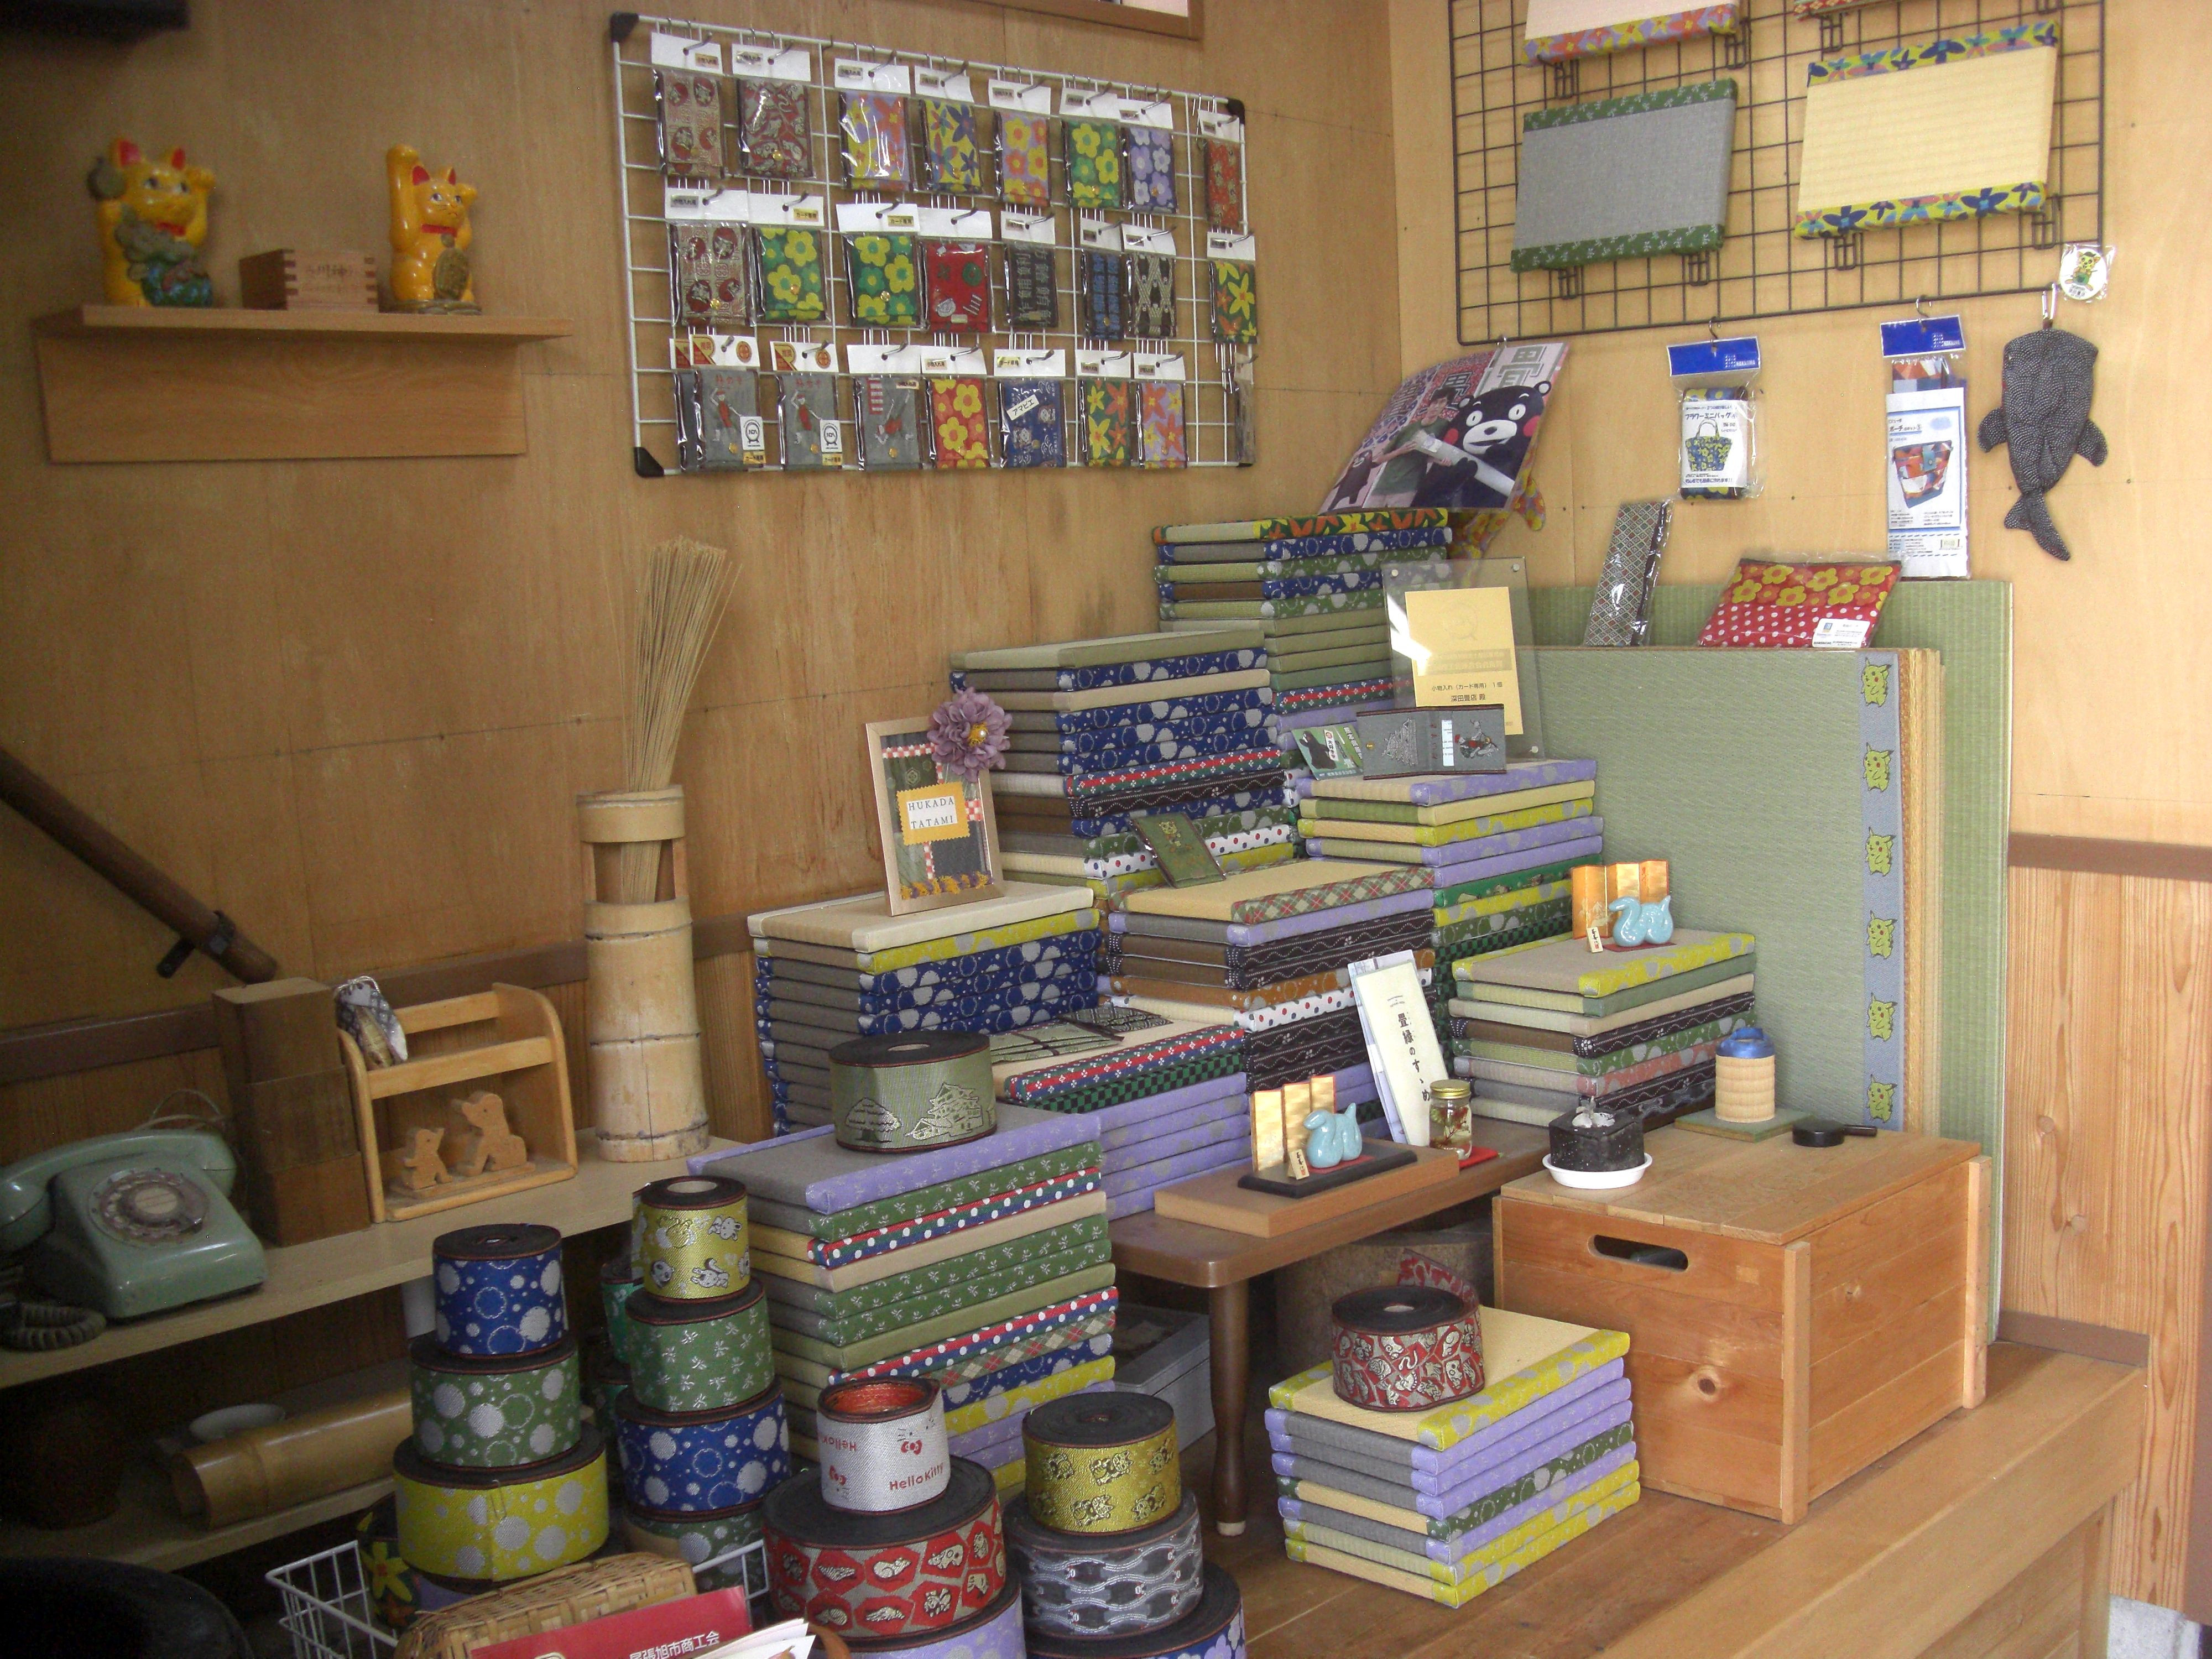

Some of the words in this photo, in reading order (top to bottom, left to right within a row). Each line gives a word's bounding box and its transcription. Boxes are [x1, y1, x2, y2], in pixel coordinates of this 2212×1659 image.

[1013, 399, 1035, 416] アマビエ
[908, 796, 954, 811] HUKADA
[911, 815, 954, 830] TATAMI
